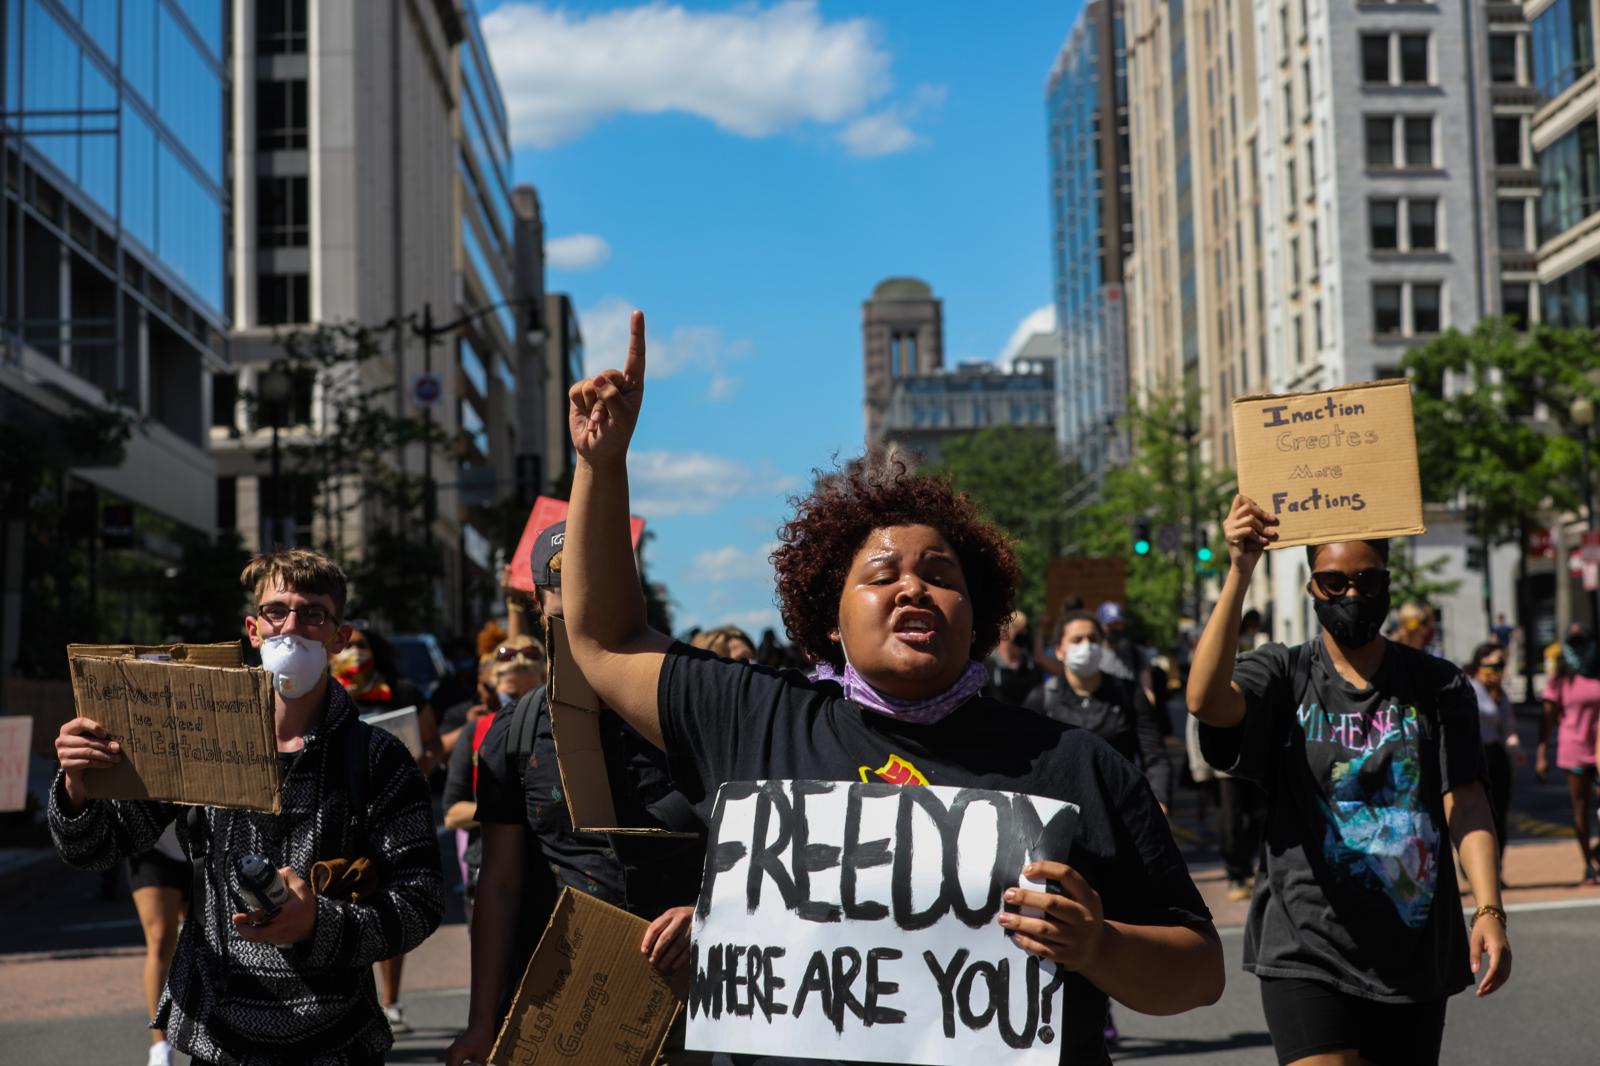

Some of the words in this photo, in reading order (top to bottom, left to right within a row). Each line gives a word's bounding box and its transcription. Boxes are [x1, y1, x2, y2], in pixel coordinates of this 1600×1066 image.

[1262, 397, 1365, 428] Inaction
[1276, 424, 1379, 452] Creates
[1288, 464, 1344, 480] More
[1272, 488, 1366, 515] Factions
[690, 941, 788, 1024] WHERE
[792, 945, 907, 1039] ARE
[922, 947, 1064, 1049] YOU?
[554, 971, 609, 1058] George
